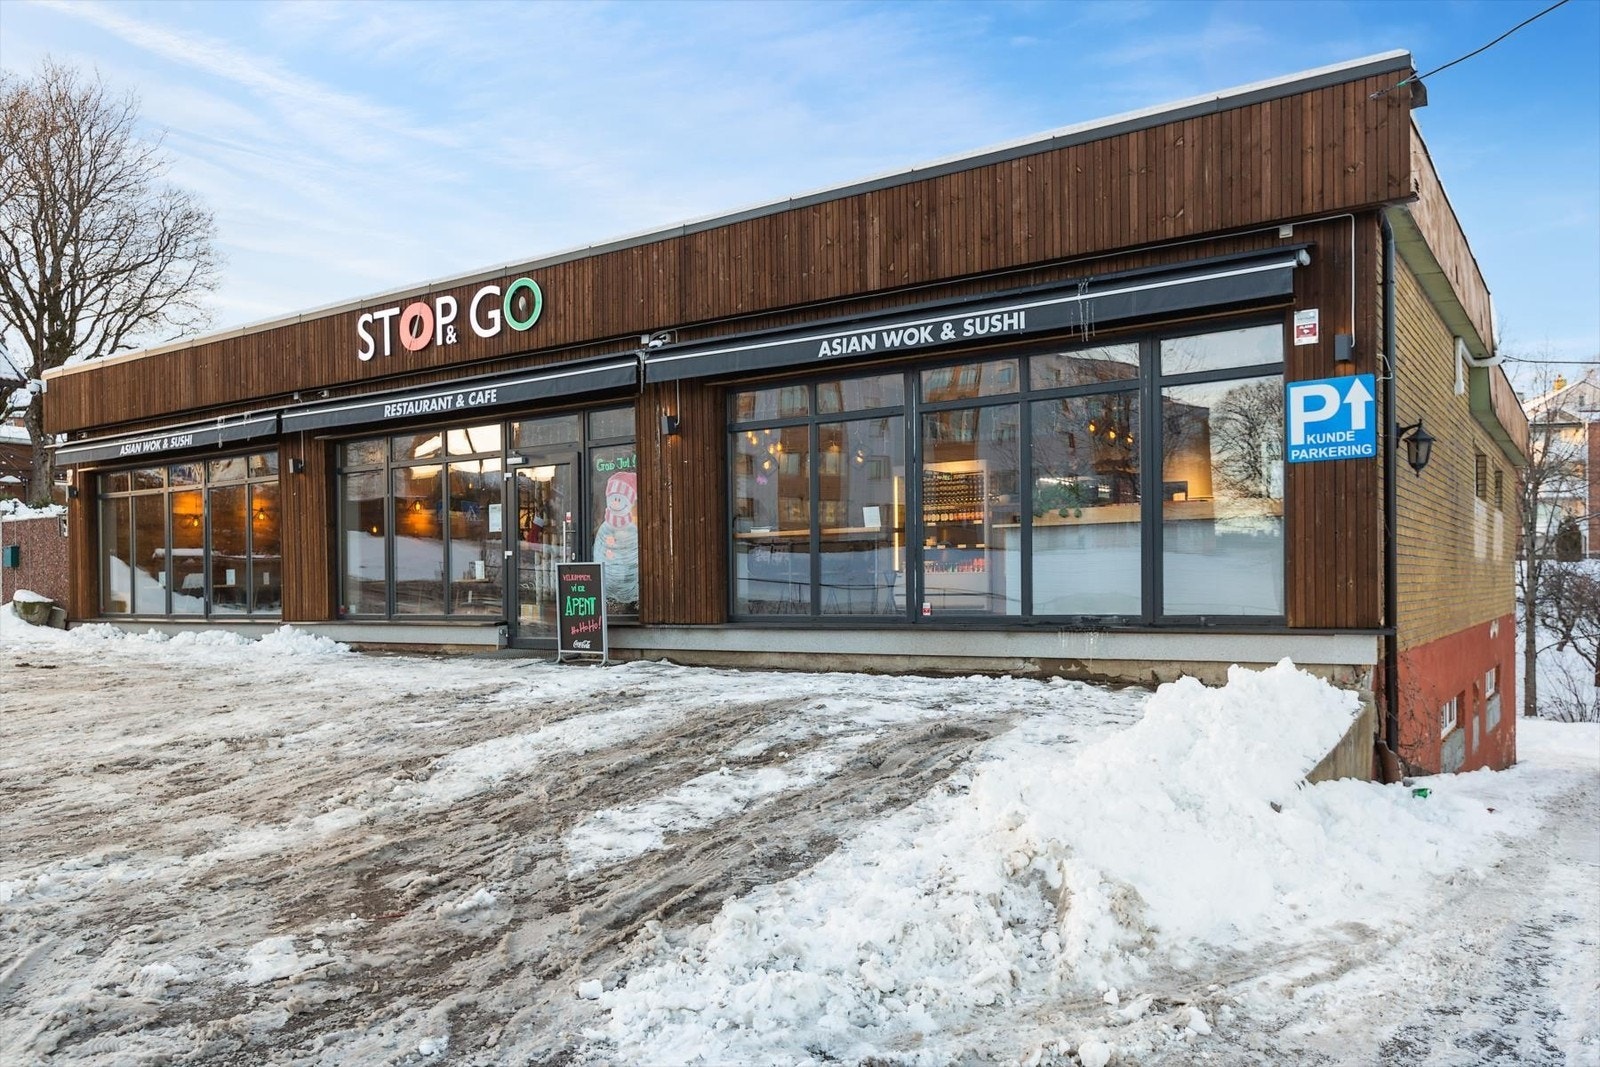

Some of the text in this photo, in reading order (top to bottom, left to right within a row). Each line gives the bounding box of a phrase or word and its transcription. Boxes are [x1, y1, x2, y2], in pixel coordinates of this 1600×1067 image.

[357, 277, 543, 362] STOP & GO
[818, 311, 1026, 358] ASIAN WOK & SUSHI
[384, 389, 497, 418] RESTAURANT & CAFE
[1290, 384, 1341, 446] P
[120, 434, 193, 456] ASIAN WOK & SUSHI
[1291, 443, 1372, 460] PARKERING
[1306, 430, 1356, 445] KUNDE
